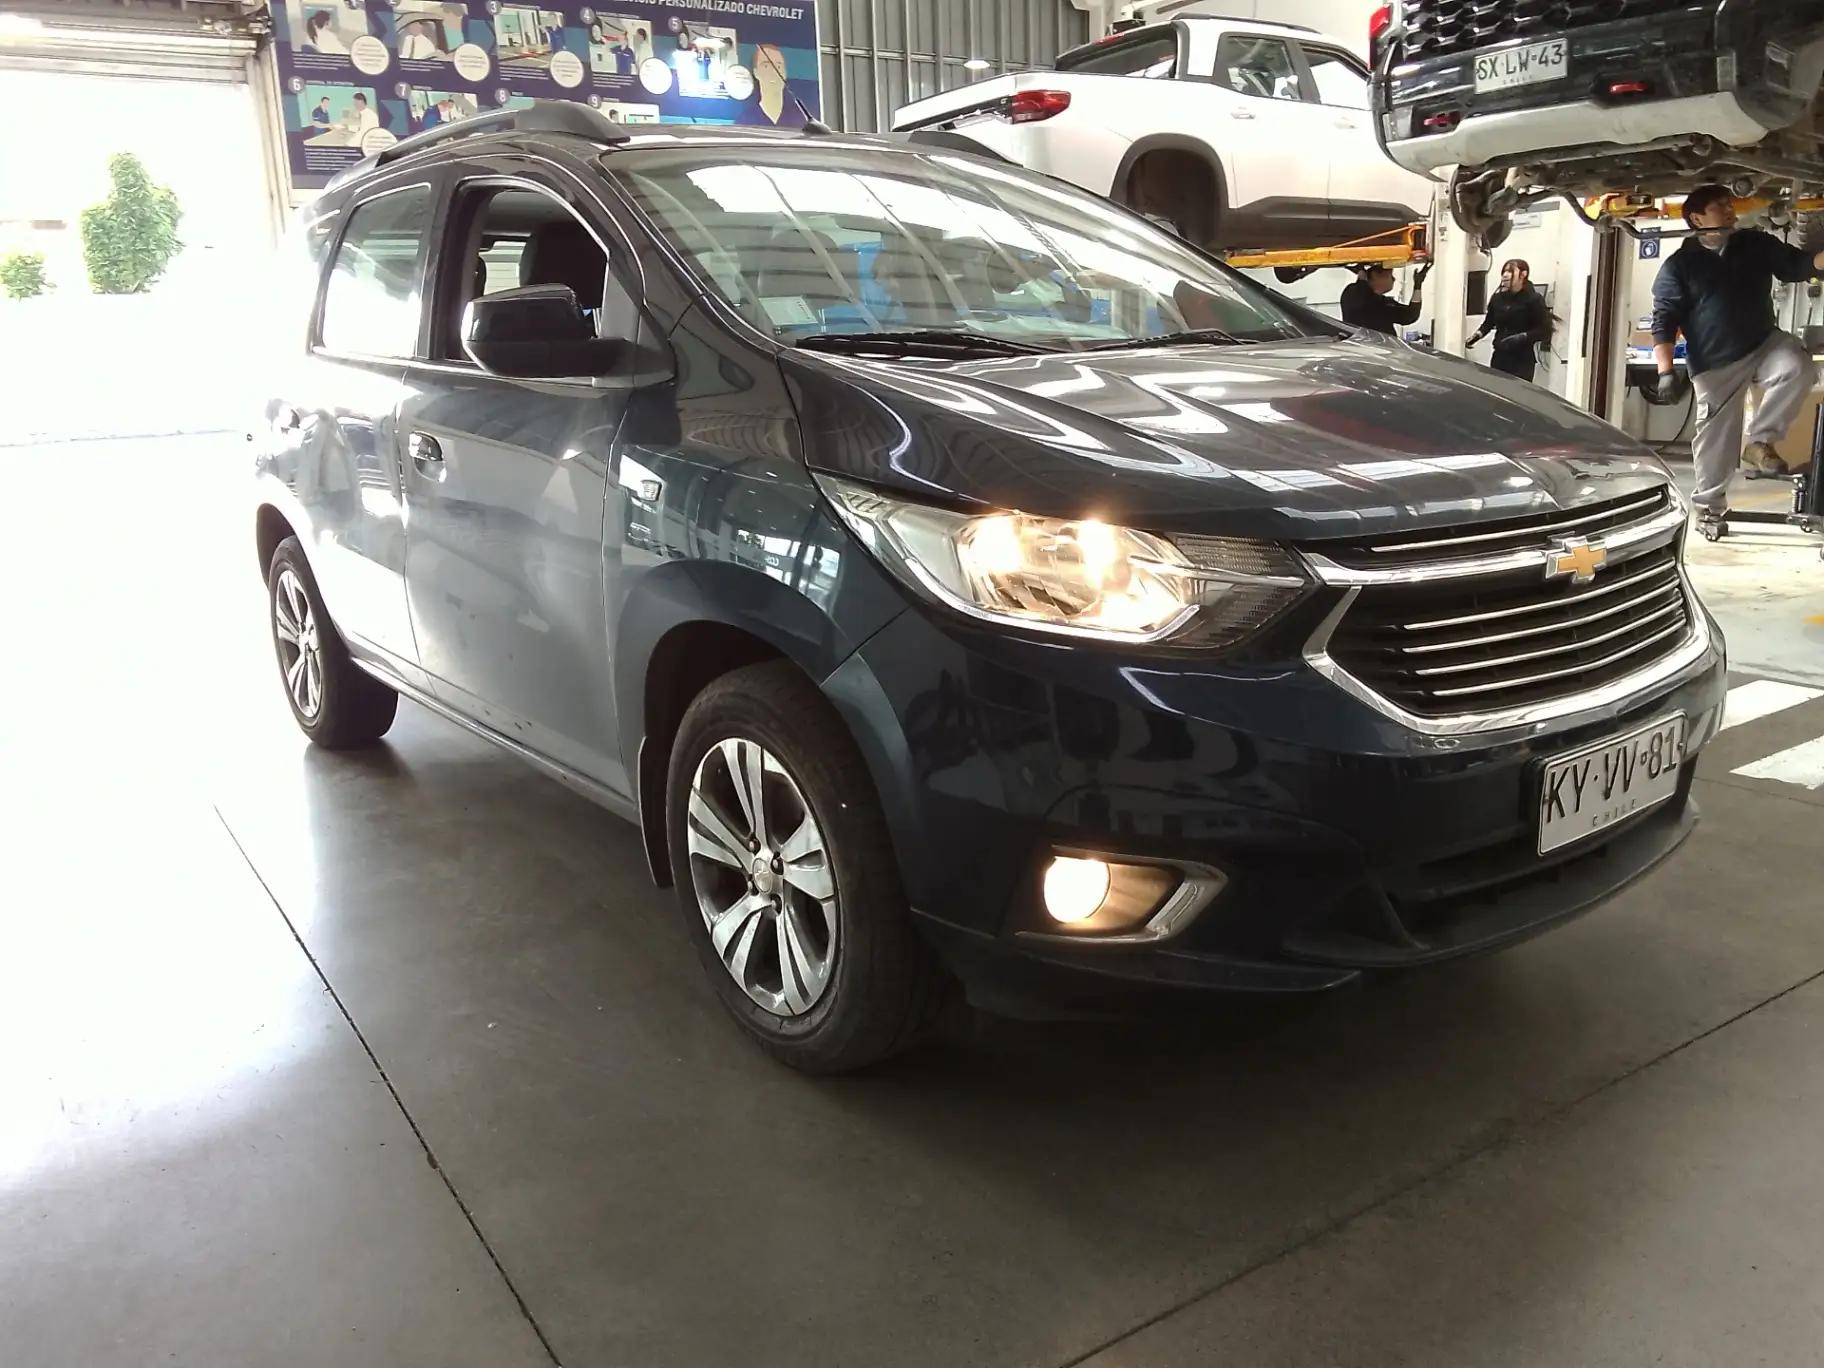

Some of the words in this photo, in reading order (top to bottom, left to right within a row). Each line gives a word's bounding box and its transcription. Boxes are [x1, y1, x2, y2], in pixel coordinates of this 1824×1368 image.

[746, 4, 804, 20] CHEVROLET
[293, 79, 301, 91] 6
[399, 84, 406, 97] 7
[499, 89, 506, 102] 8
